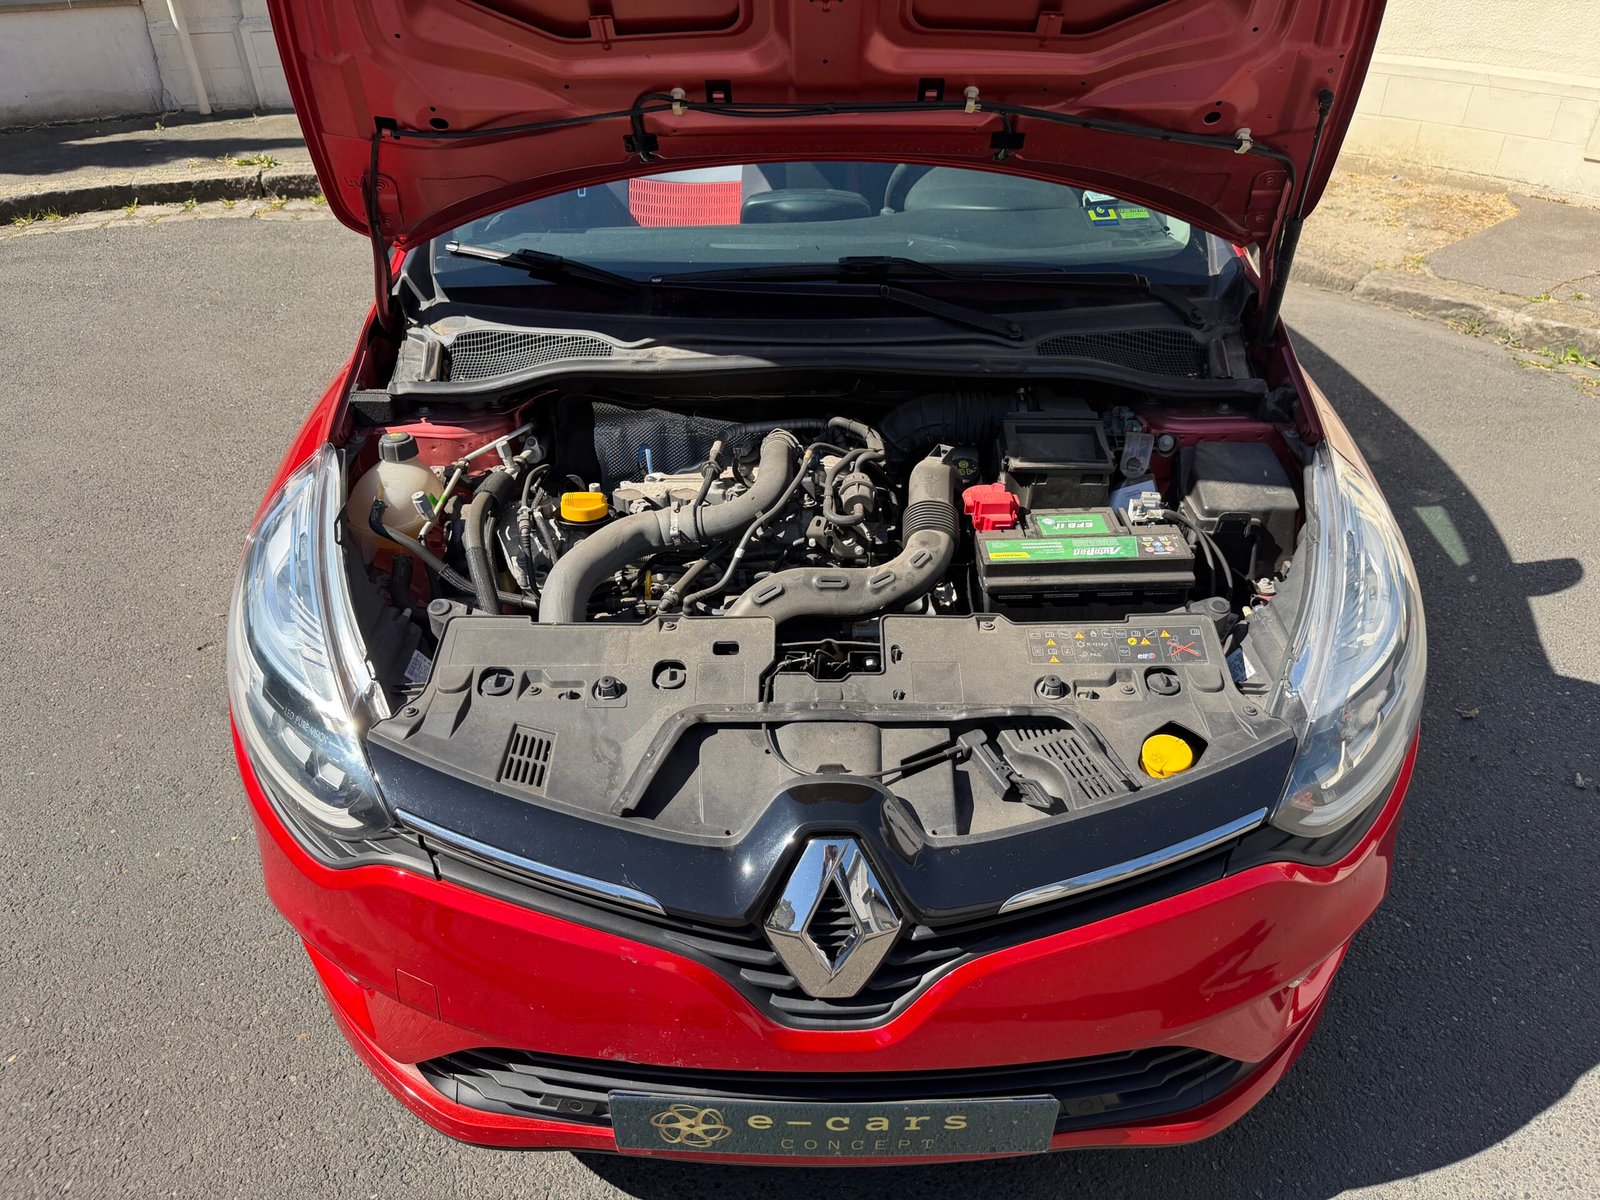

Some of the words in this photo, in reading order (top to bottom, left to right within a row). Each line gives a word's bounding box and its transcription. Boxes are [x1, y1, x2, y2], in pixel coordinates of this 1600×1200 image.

[284, 706, 295, 720] LED
[747, 1114, 968, 1132] e-cars
[780, 1139, 934, 1150] CONCEPT
